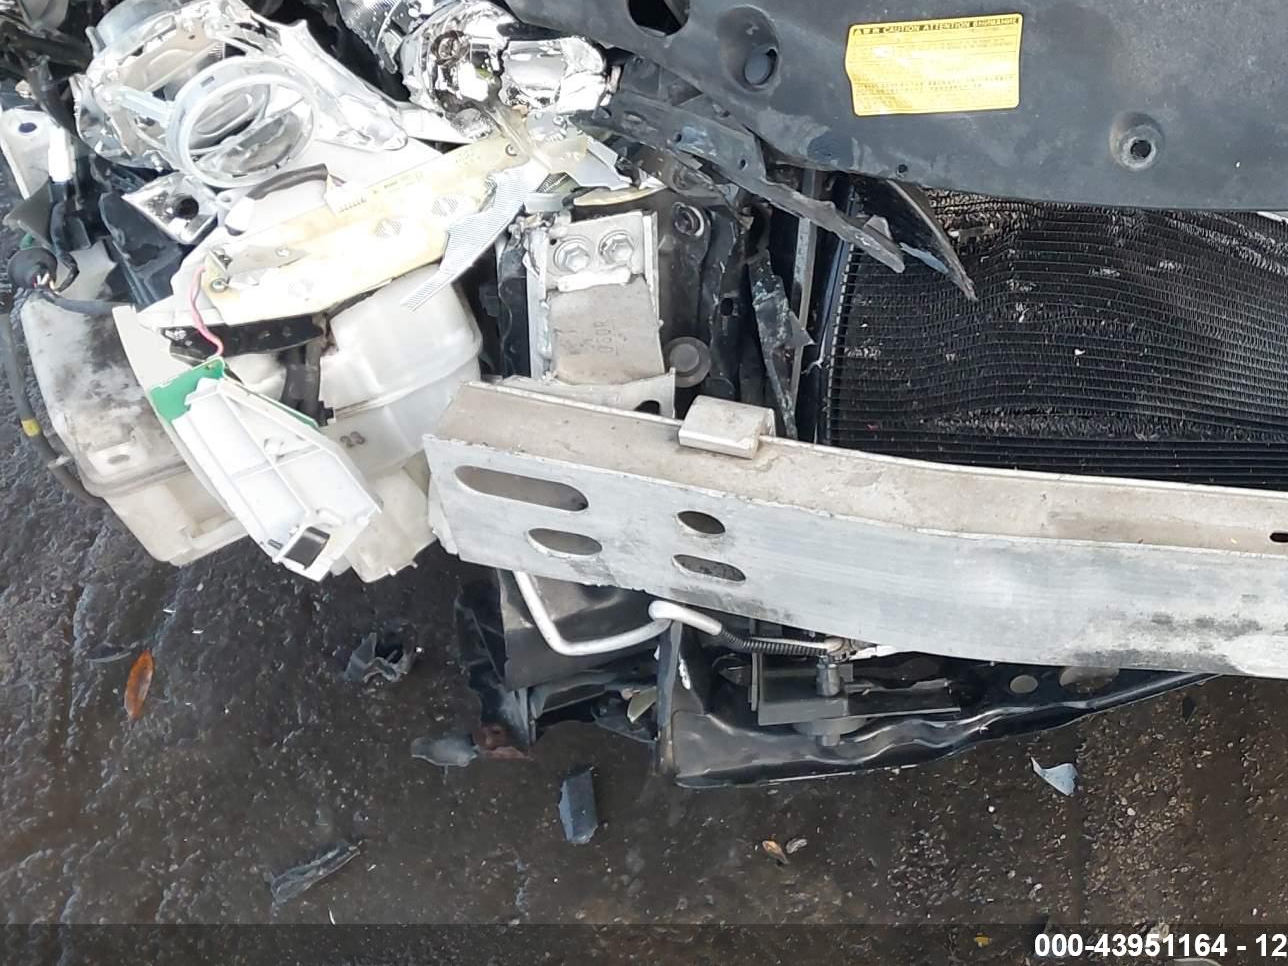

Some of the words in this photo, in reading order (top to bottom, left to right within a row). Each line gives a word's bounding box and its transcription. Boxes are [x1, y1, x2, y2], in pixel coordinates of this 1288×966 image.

[884, 24, 920, 34] CAUTION
[924, 21, 970, 32] ATTENTION
[340, 431, 366, 449] 23
